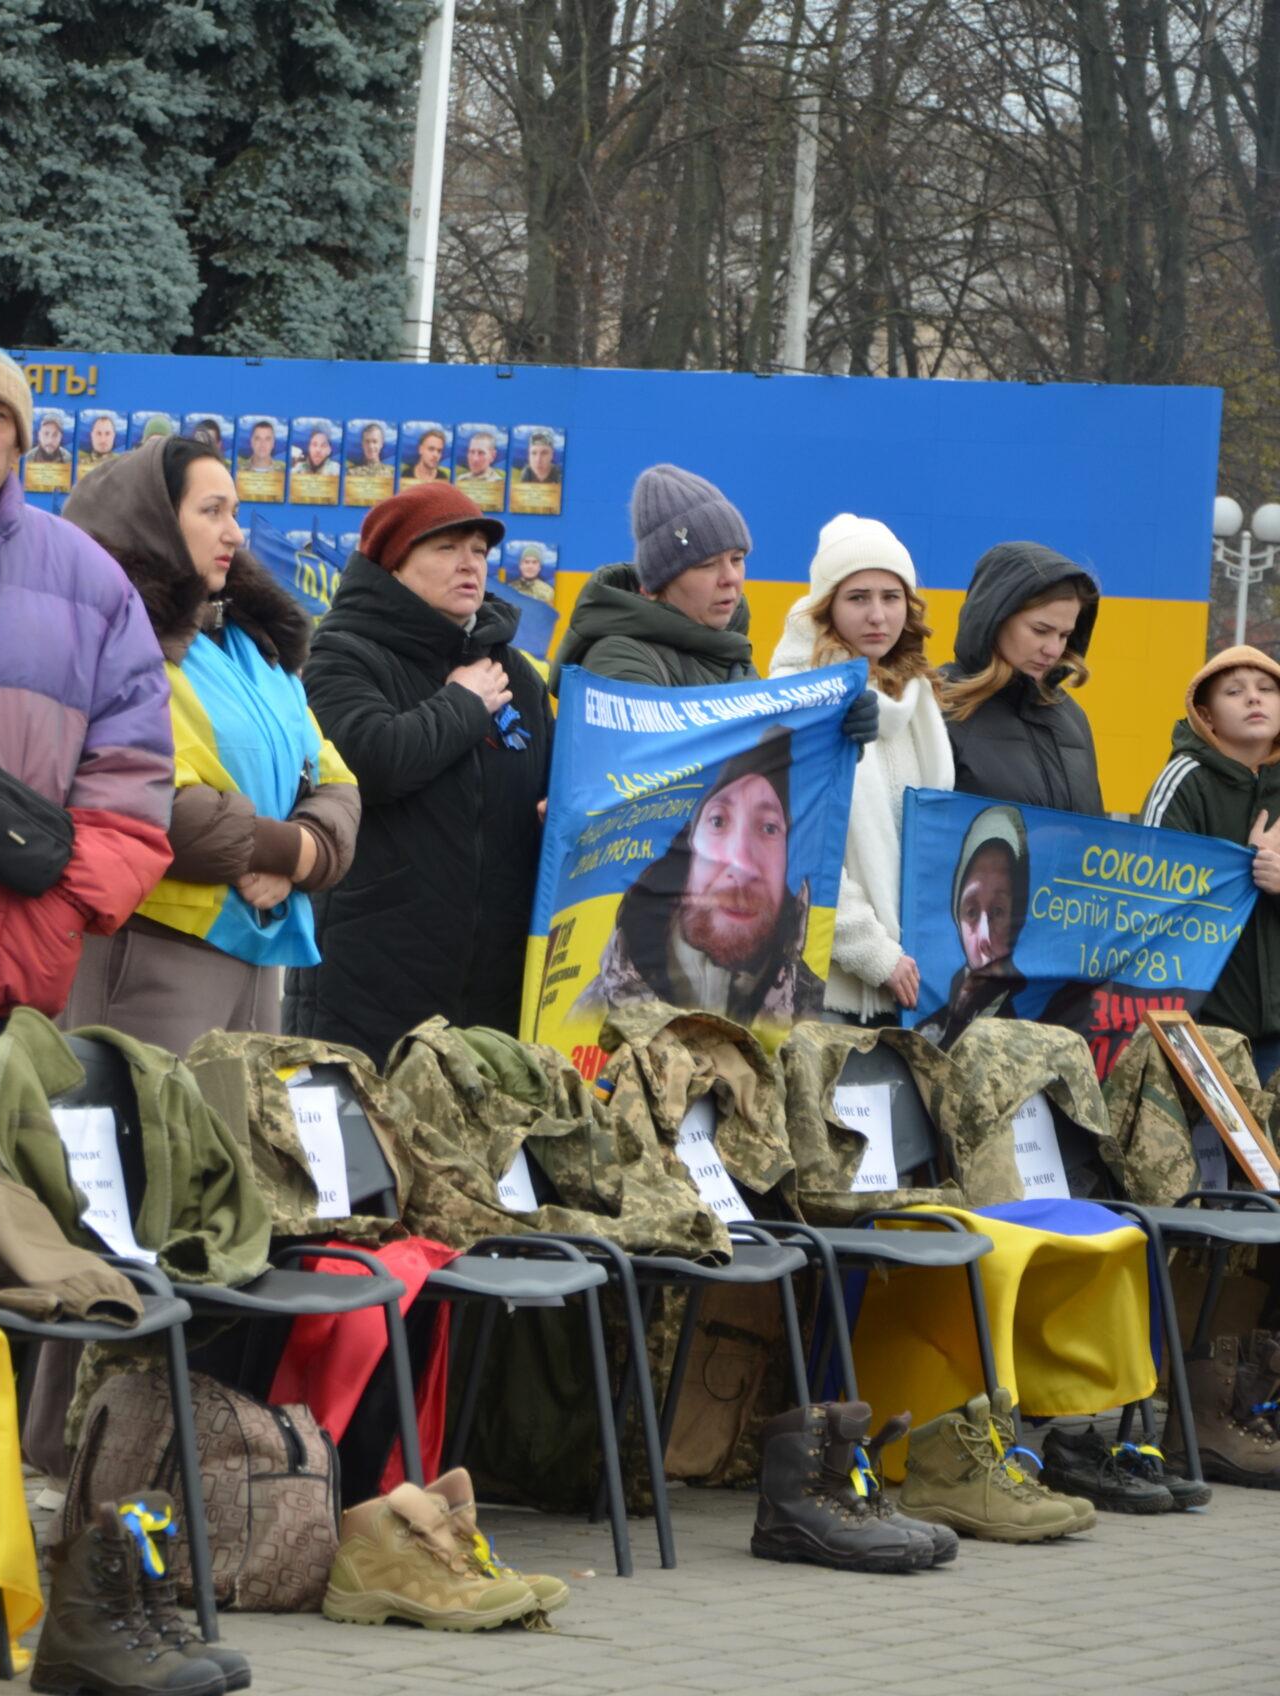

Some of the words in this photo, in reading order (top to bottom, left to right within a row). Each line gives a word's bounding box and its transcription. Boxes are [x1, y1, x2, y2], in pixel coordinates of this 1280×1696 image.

[23, 363, 98, 396] ЯТЬ!
[1081, 845, 1215, 896] СОКОЛЮК
[1031, 886, 1109, 930] Сергій
